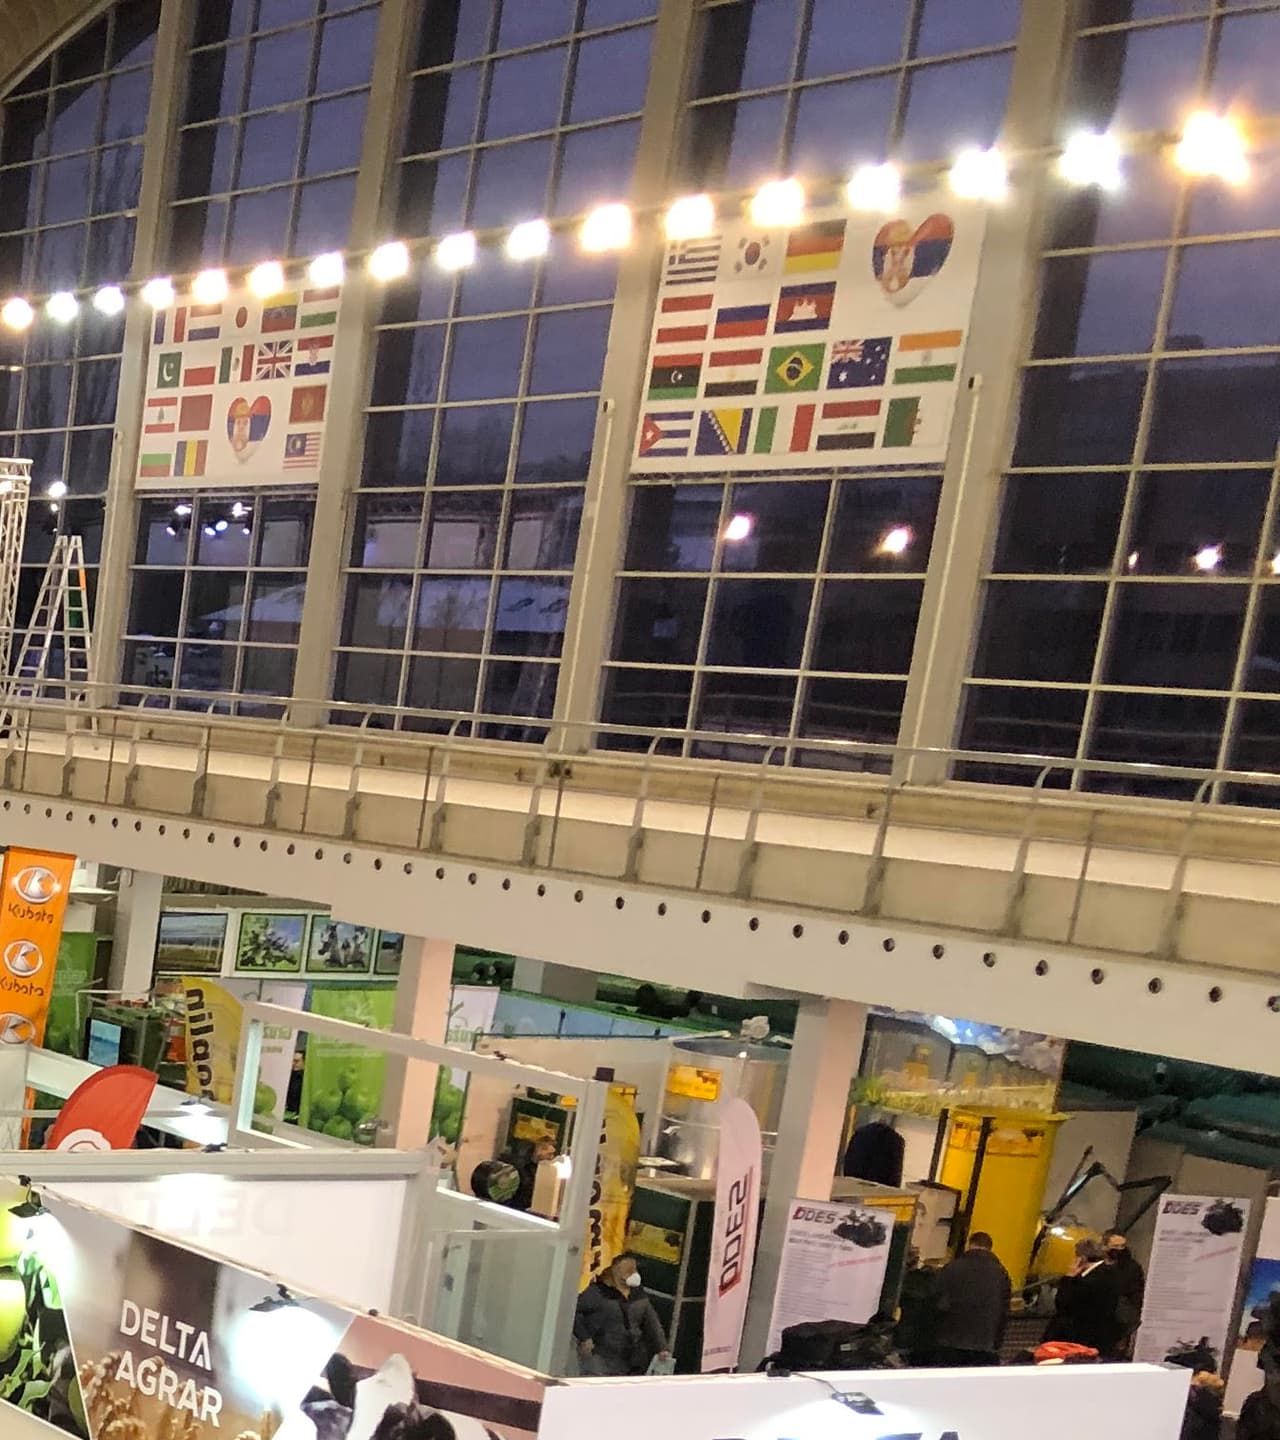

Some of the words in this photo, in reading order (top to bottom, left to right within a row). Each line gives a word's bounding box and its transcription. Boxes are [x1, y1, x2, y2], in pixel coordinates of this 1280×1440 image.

[8, 902, 55, 924] Kubota
[119, 1299, 213, 1372] DELTA
[114, 1350, 223, 1428] AGRAR
